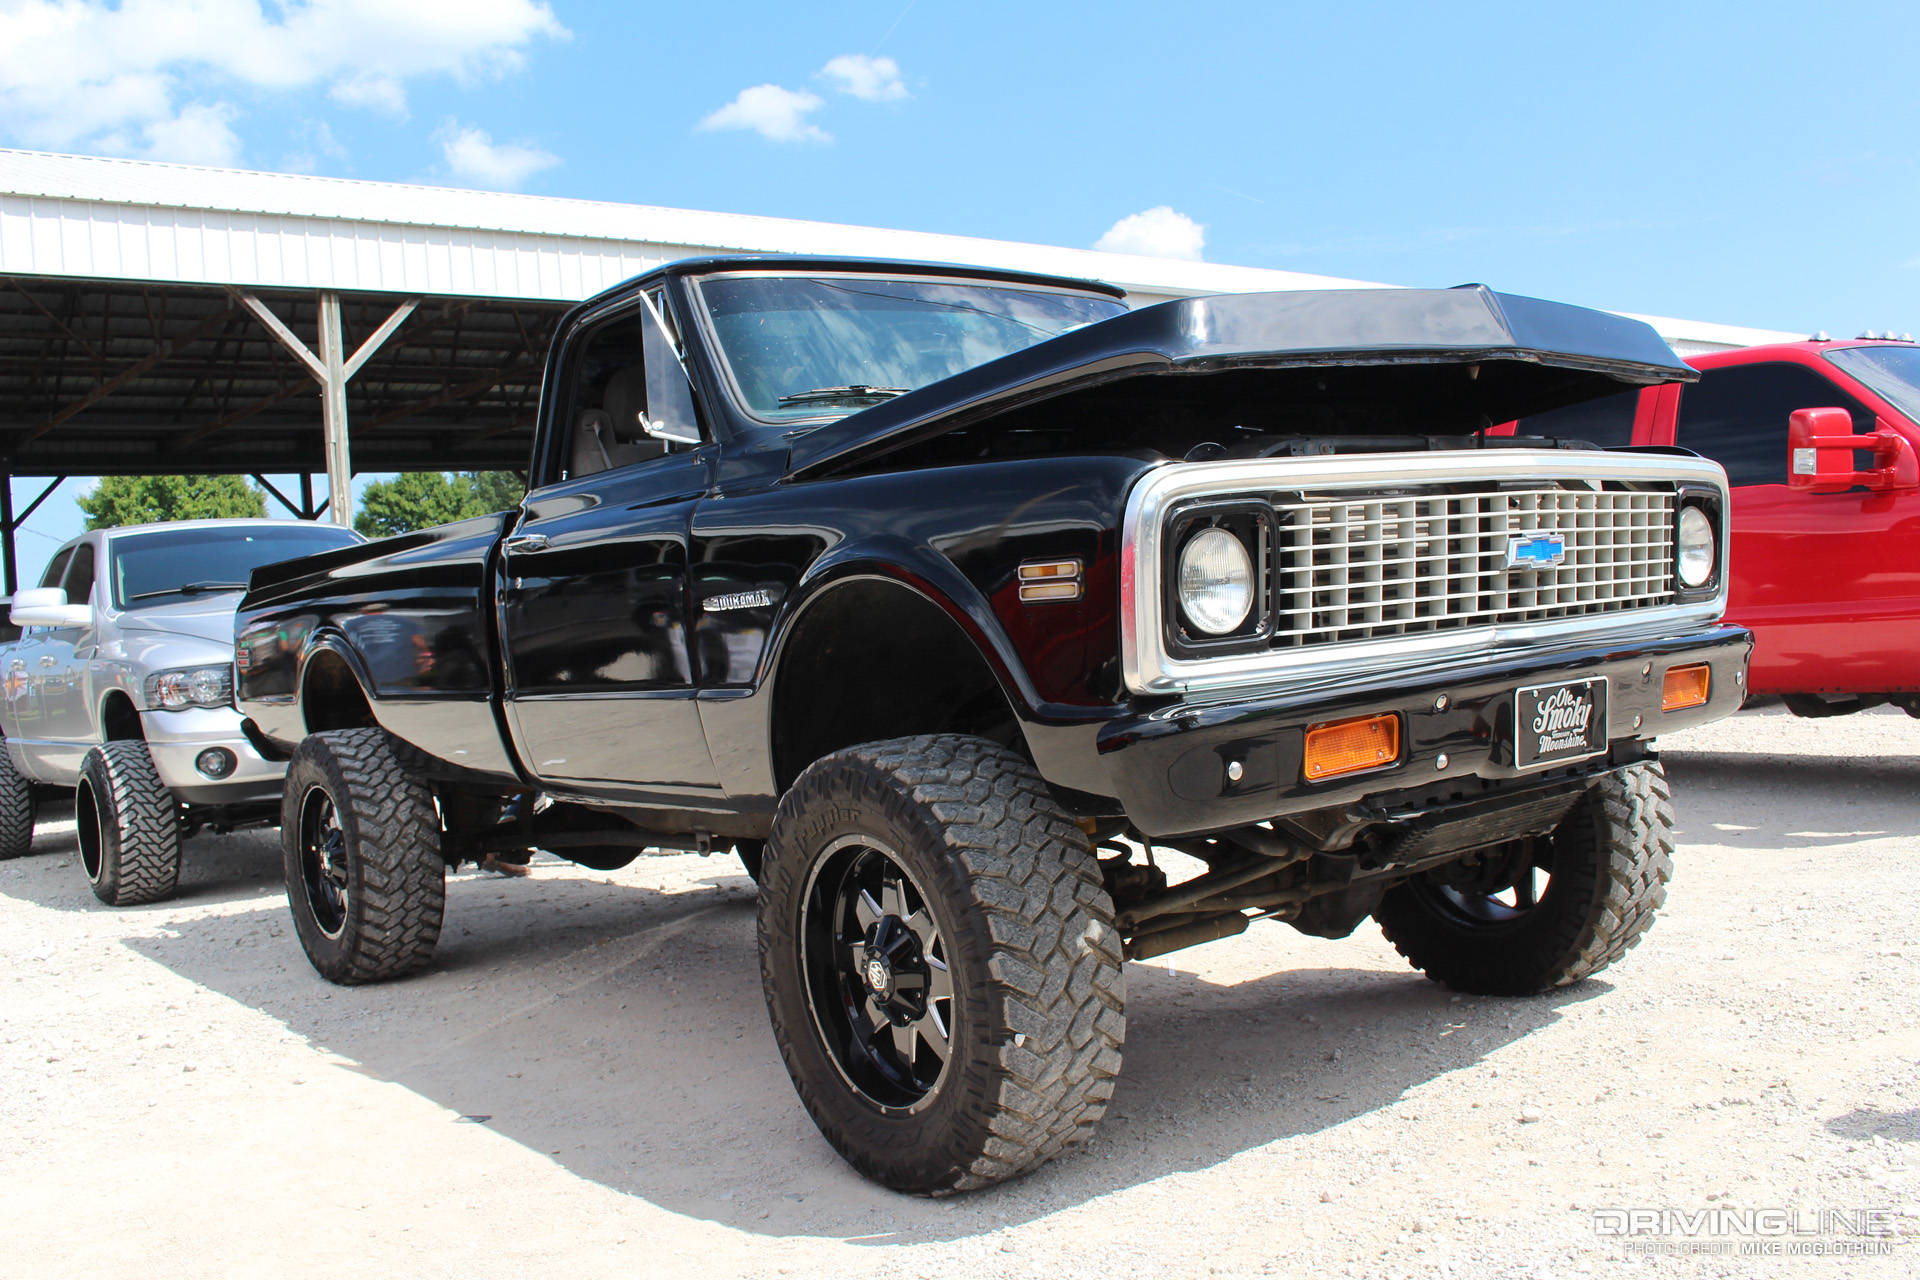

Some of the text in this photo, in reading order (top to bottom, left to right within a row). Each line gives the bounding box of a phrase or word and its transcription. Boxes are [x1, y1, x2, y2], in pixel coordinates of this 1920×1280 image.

[1556, 687, 1576, 707] Ole
[1533, 695, 1592, 734] Smoky
[1539, 735, 1587, 753] Moonshine
